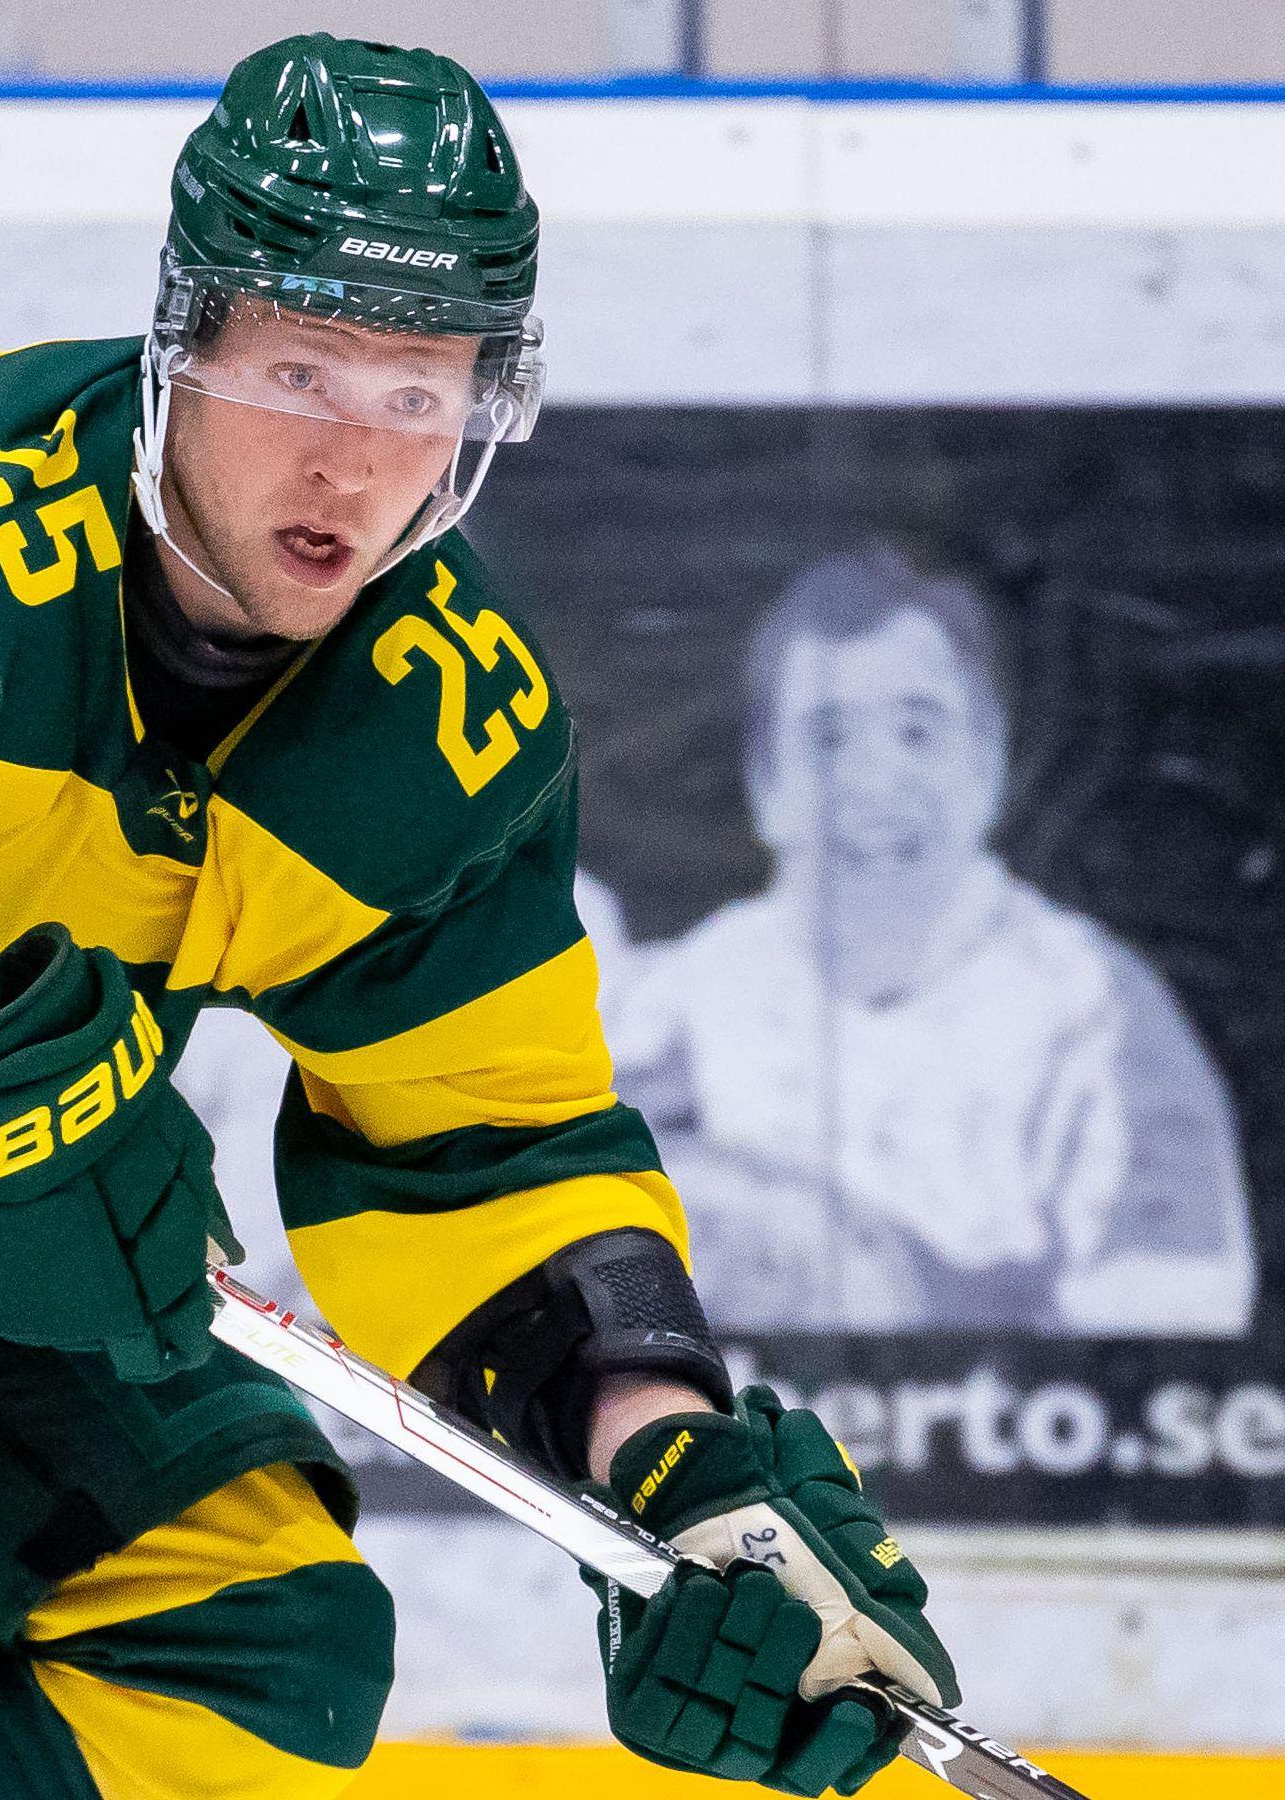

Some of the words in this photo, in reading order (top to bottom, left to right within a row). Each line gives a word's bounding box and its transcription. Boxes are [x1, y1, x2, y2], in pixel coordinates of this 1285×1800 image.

[339, 236, 458, 271] BAUER
[372, 560, 550, 797] 25
[631, 1430, 694, 1516] BAUER
